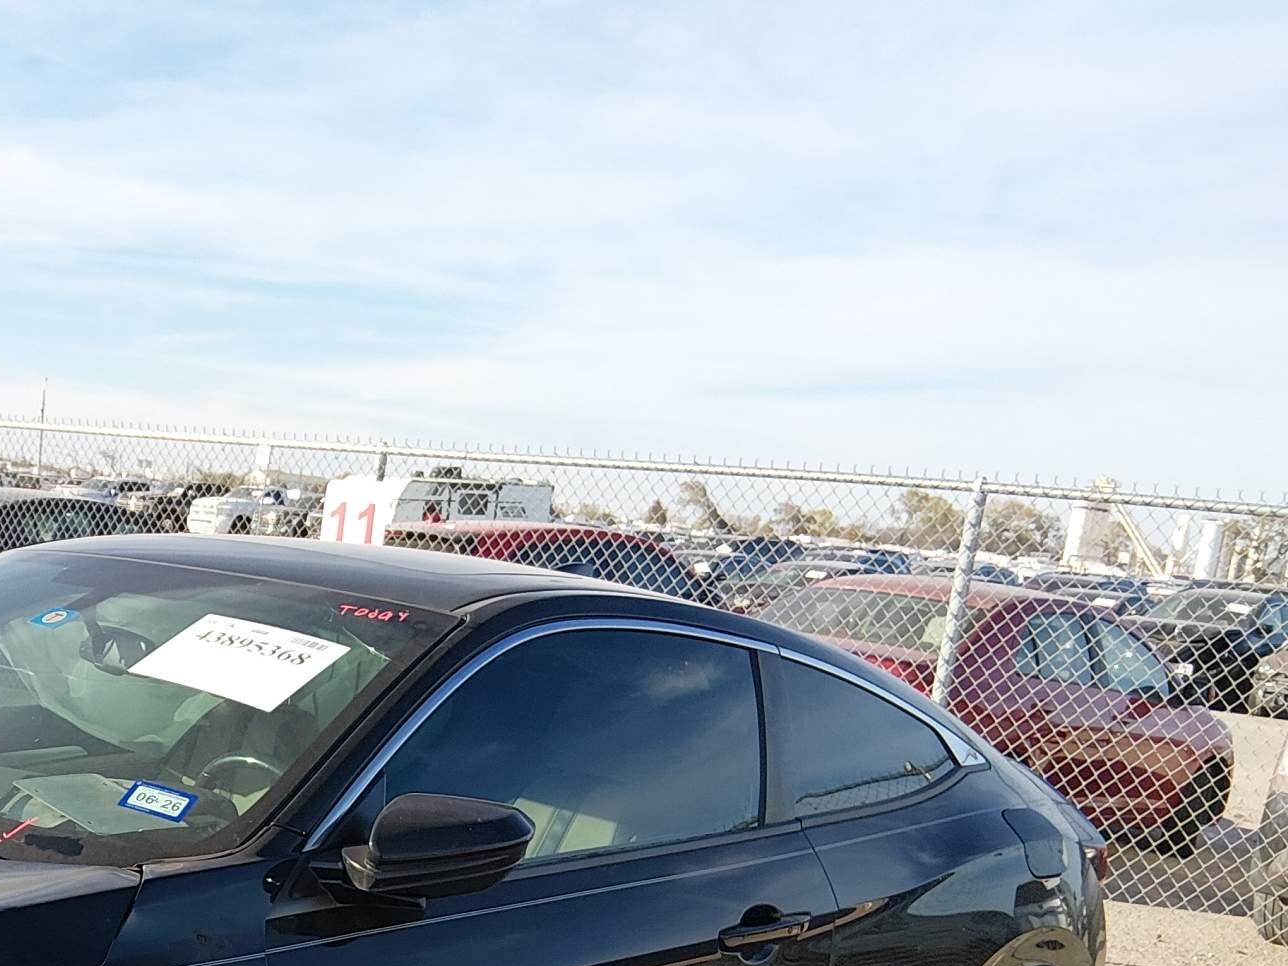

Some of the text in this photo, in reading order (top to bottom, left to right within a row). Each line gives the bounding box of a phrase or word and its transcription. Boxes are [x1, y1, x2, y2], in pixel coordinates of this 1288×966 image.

[330, 502, 376, 545] 11
[196, 630, 312, 666] 43895368
[135, 792, 157, 805] 06
[160, 799, 183, 812] 26
